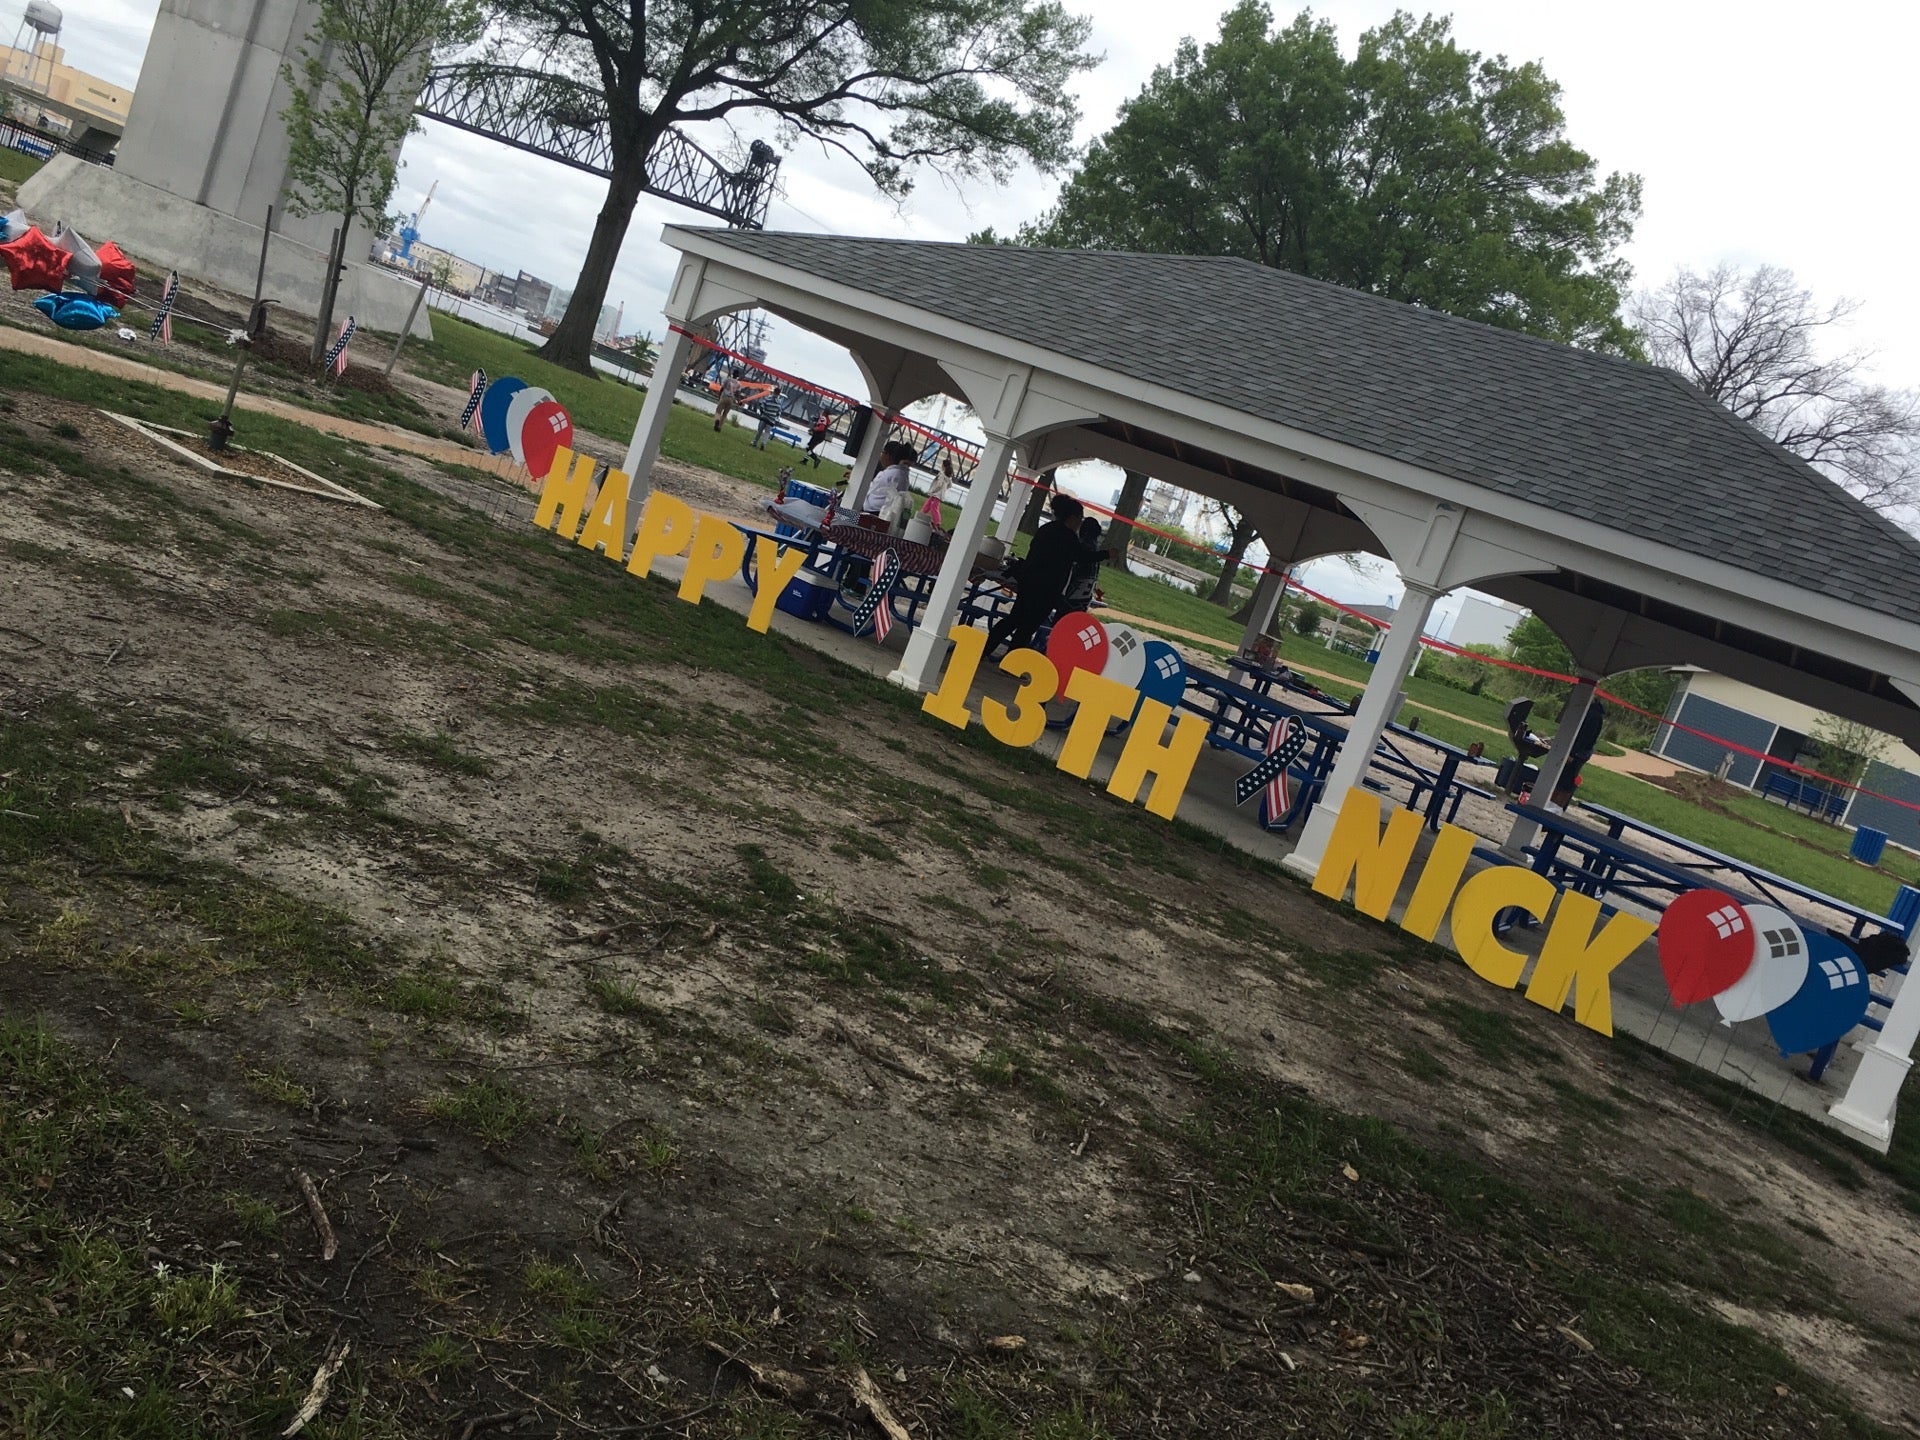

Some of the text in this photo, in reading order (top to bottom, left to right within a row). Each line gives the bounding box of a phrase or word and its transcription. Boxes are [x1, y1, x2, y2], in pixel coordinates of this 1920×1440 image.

[533, 446, 1658, 1038] HAPPY 13TH NICK
